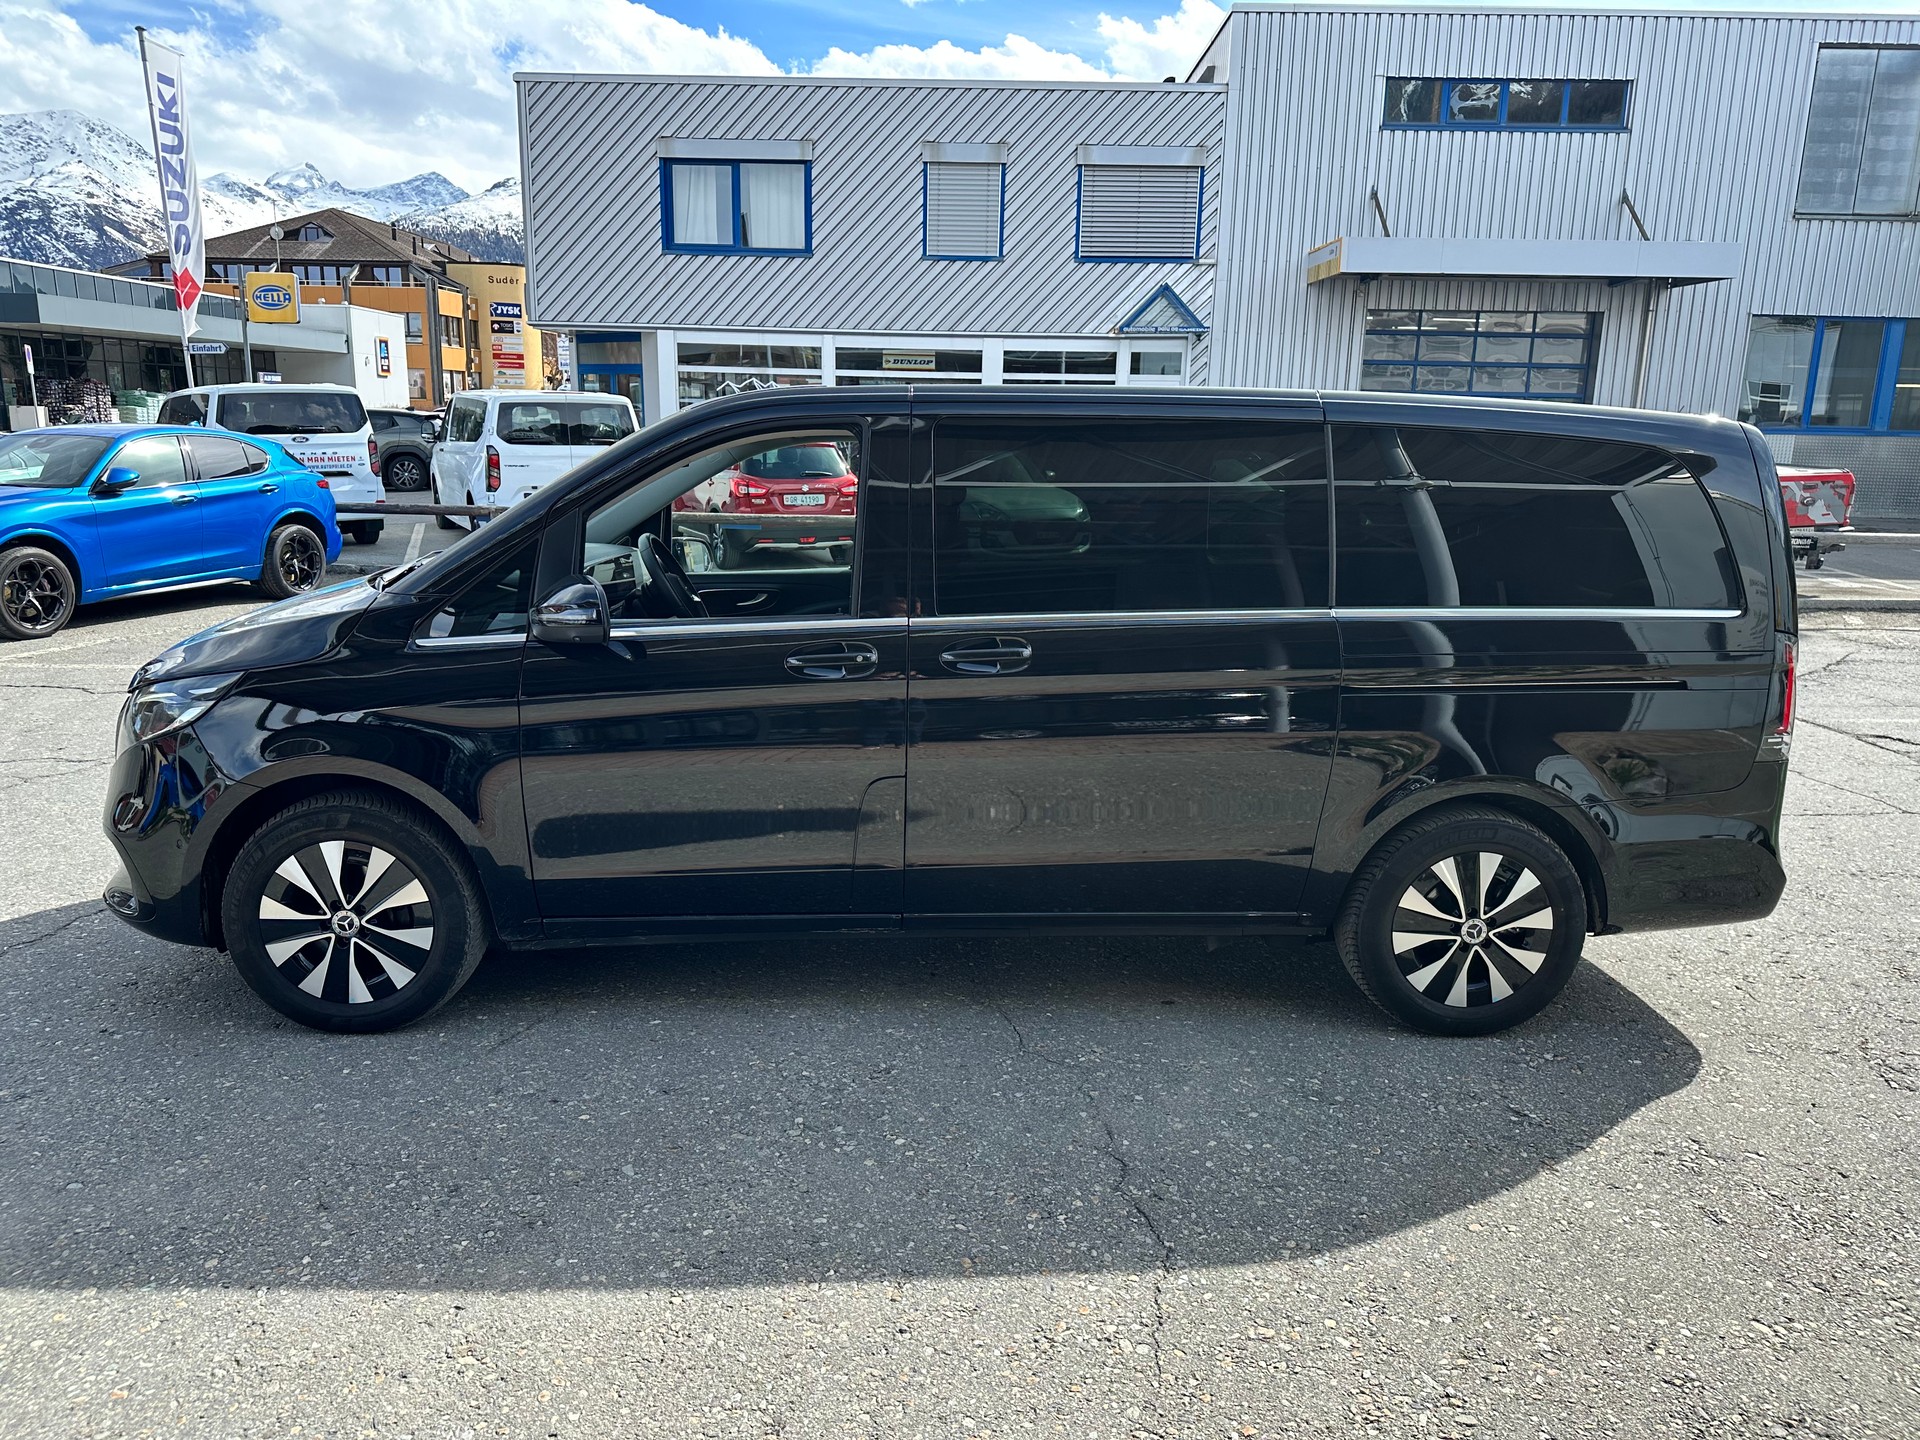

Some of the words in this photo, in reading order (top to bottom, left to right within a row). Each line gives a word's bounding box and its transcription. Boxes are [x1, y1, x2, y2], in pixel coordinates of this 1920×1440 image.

[157, 71, 191, 256] SUZUKI
[487, 275, 519, 285] Sudèr
[255, 292, 292, 304] HELLA
[496, 305, 521, 315] JYSK
[191, 344, 223, 352] Einfahrt
[892, 358, 933, 366] DUNLOP
